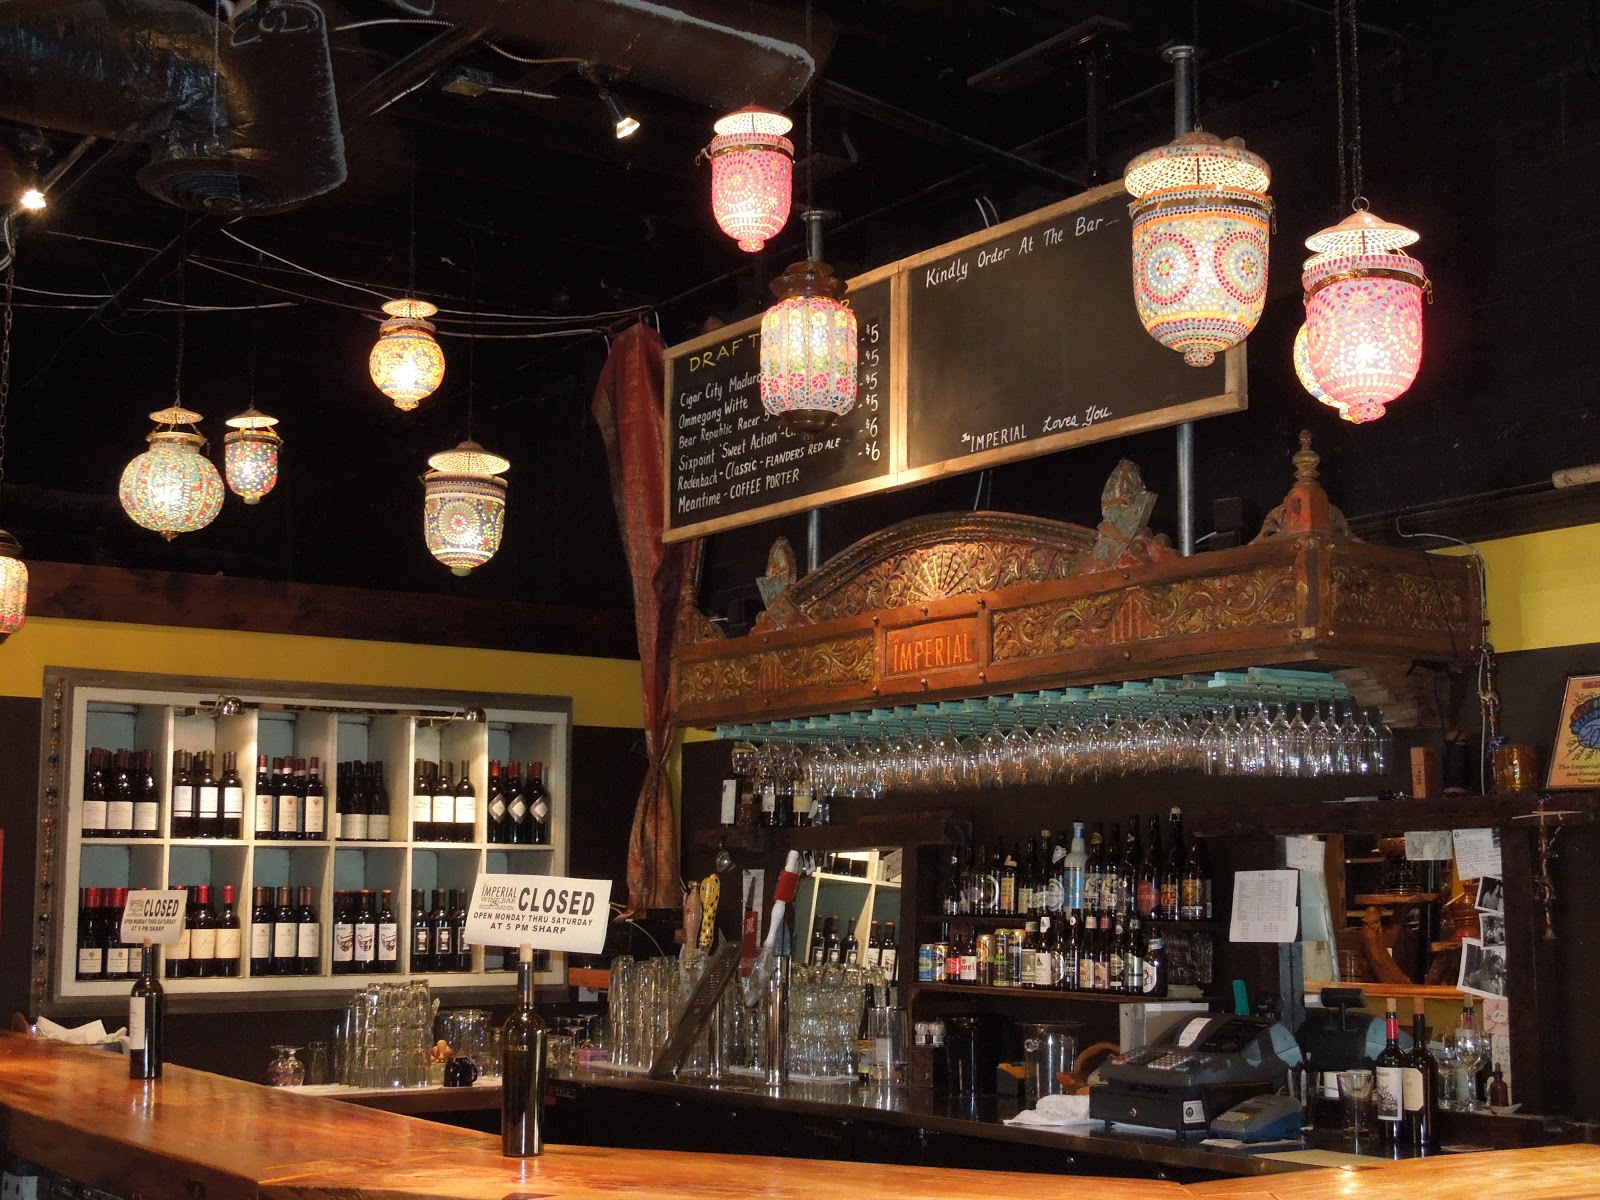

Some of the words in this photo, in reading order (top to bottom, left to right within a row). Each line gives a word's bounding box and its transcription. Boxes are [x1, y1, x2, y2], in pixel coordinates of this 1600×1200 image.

[926, 258, 969, 288] Kindly
[977, 246, 1011, 268] Order
[1018, 236, 1035, 256] At
[1043, 227, 1065, 247] The
[689, 333, 760, 373] DRAFT
[679, 391, 703, 410] Cigar
[705, 381, 723, 402] City
[678, 408, 722, 430] Ommegang
[724, 396, 749, 416] Witte
[678, 435, 698, 450] Bear
[700, 422, 734, 444] Republic
[737, 416, 761, 432] Racer
[970, 424, 1028, 453] IMPERIAL
[1042, 416, 1080, 433] Loves
[677, 468, 719, 492] Rodenbach
[725, 457, 758, 480] Classic
[765, 446, 805, 469] FLANDERS
[807, 442, 825, 456] RED
[824, 437, 842, 451] ALE
[678, 448, 717, 474] Sixpoint
[678, 491, 721, 514] Meantime
[729, 477, 762, 500] COFFEE
[765, 468, 800, 491] PORTER
[893, 632, 972, 672] IMPERIAL
[143, 899, 180, 917] CLOSED
[481, 886, 517, 899] IMPERIAL
[518, 886, 596, 917] CLOSED
[473, 911, 493, 920] OPEN
[494, 912, 526, 922] MONDAY
[528, 914, 549, 923] THRU
[551, 916, 593, 927] SATURDAY
[490, 922, 503, 930] AT
[505, 923, 512, 931] 5
[515, 924, 529, 932] PM
[532, 924, 566, 934] SHARP
